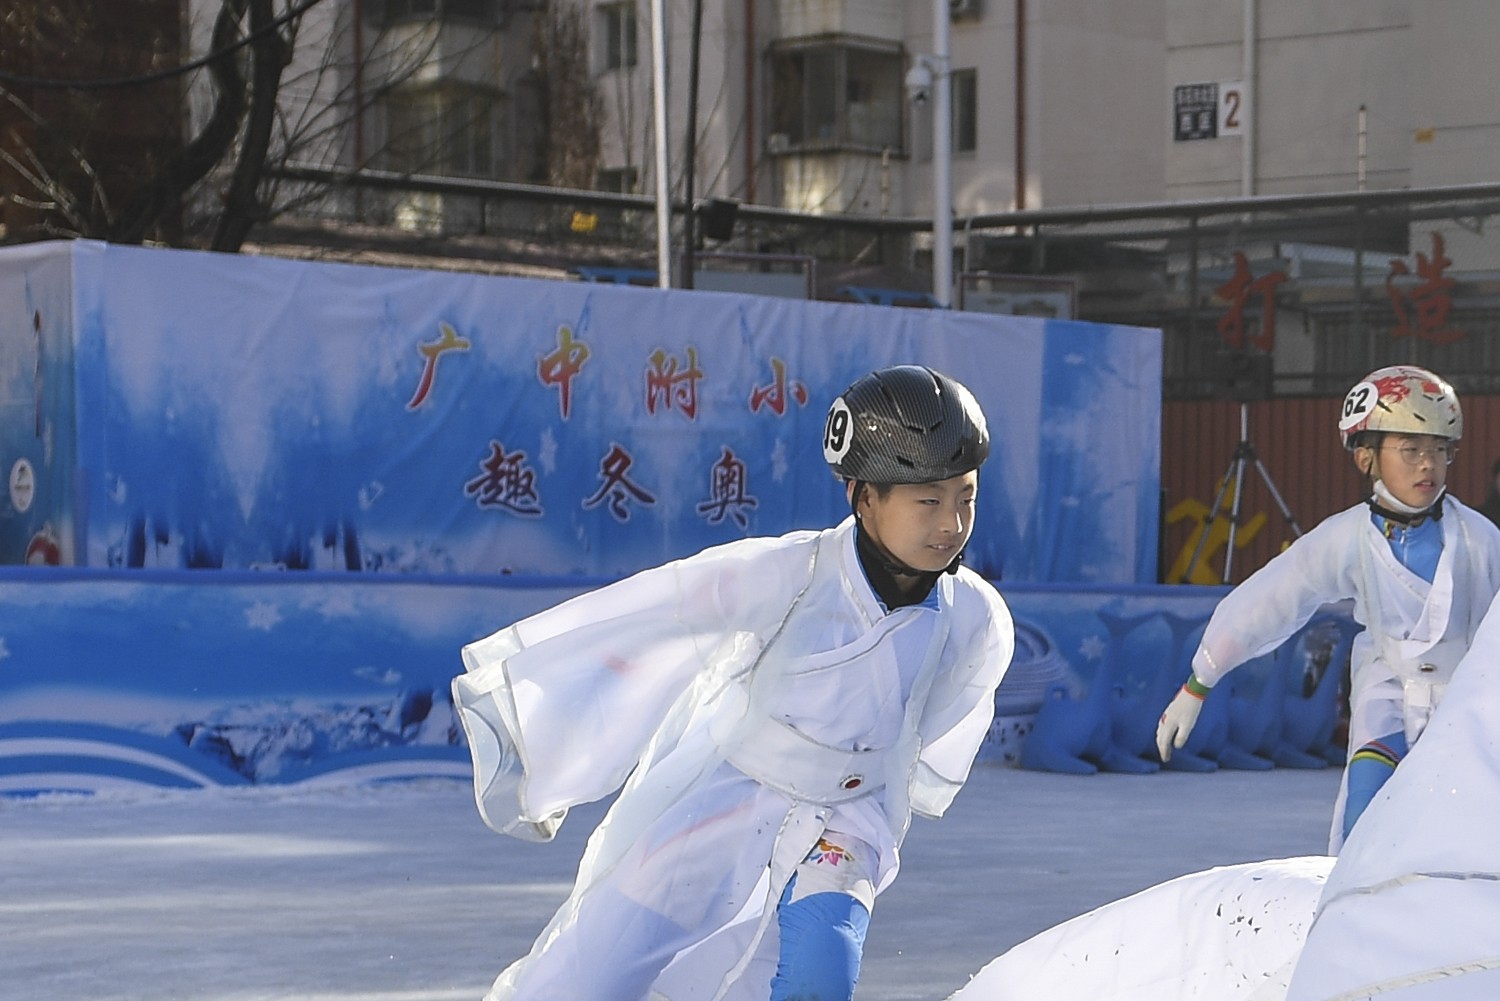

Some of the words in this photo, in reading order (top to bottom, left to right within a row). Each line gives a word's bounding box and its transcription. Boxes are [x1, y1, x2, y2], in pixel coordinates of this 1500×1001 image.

[1225, 90, 1241, 128] 2
[405, 322, 808, 420] 广中附小
[464, 440, 758, 528] 趣冬奥
